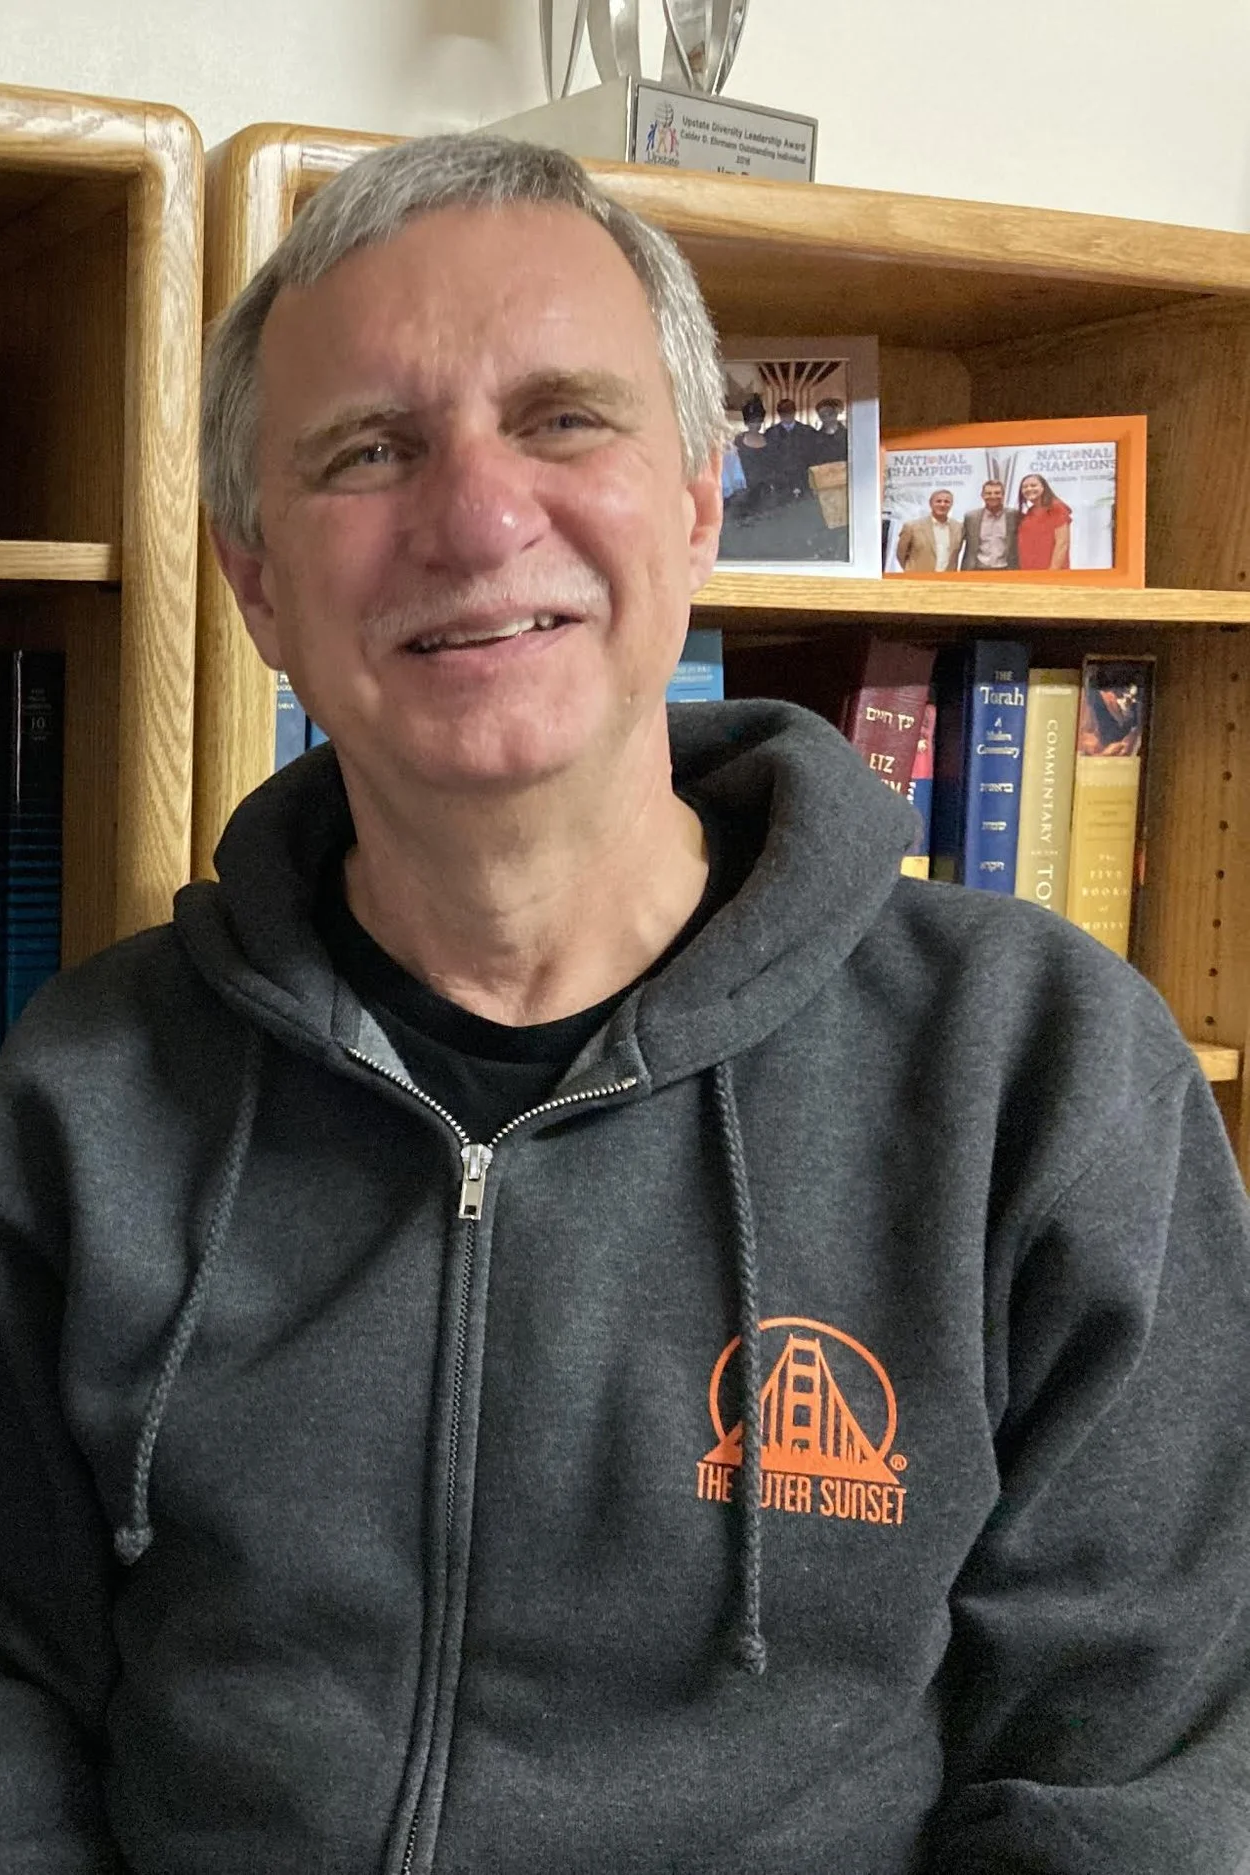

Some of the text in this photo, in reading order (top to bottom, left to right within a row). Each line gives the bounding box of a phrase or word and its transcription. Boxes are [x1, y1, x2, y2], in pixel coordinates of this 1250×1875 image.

[682, 115, 806, 151] Upstate Diversity Leadership Award
[979, 685, 1025, 706] Torah
[869, 753, 896, 774] ETZ
[1039, 719, 1059, 844] COMMENTARY
[696, 1461, 908, 1525] THE UTER SUNSET
